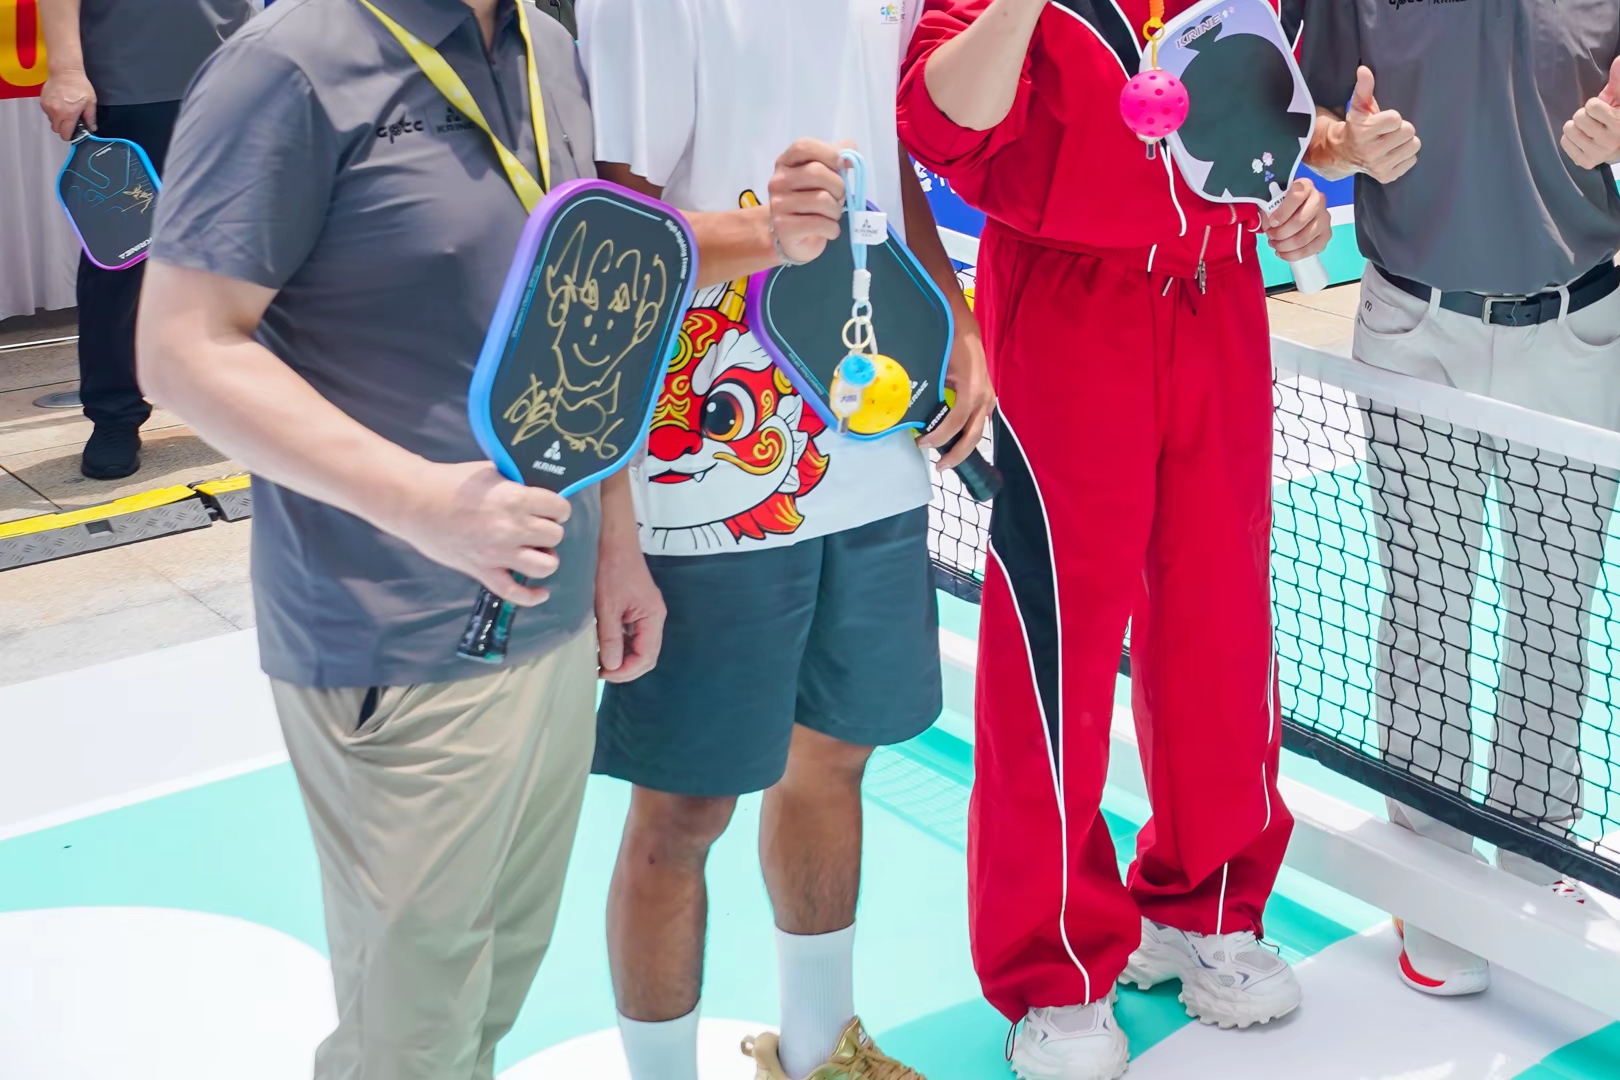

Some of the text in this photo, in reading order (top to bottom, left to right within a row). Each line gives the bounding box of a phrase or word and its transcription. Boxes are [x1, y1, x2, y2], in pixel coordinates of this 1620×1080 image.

[1176, 13, 1222, 49] KRINE
[926, 405, 949, 432] KRINE
[531, 460, 567, 476] KRINE
